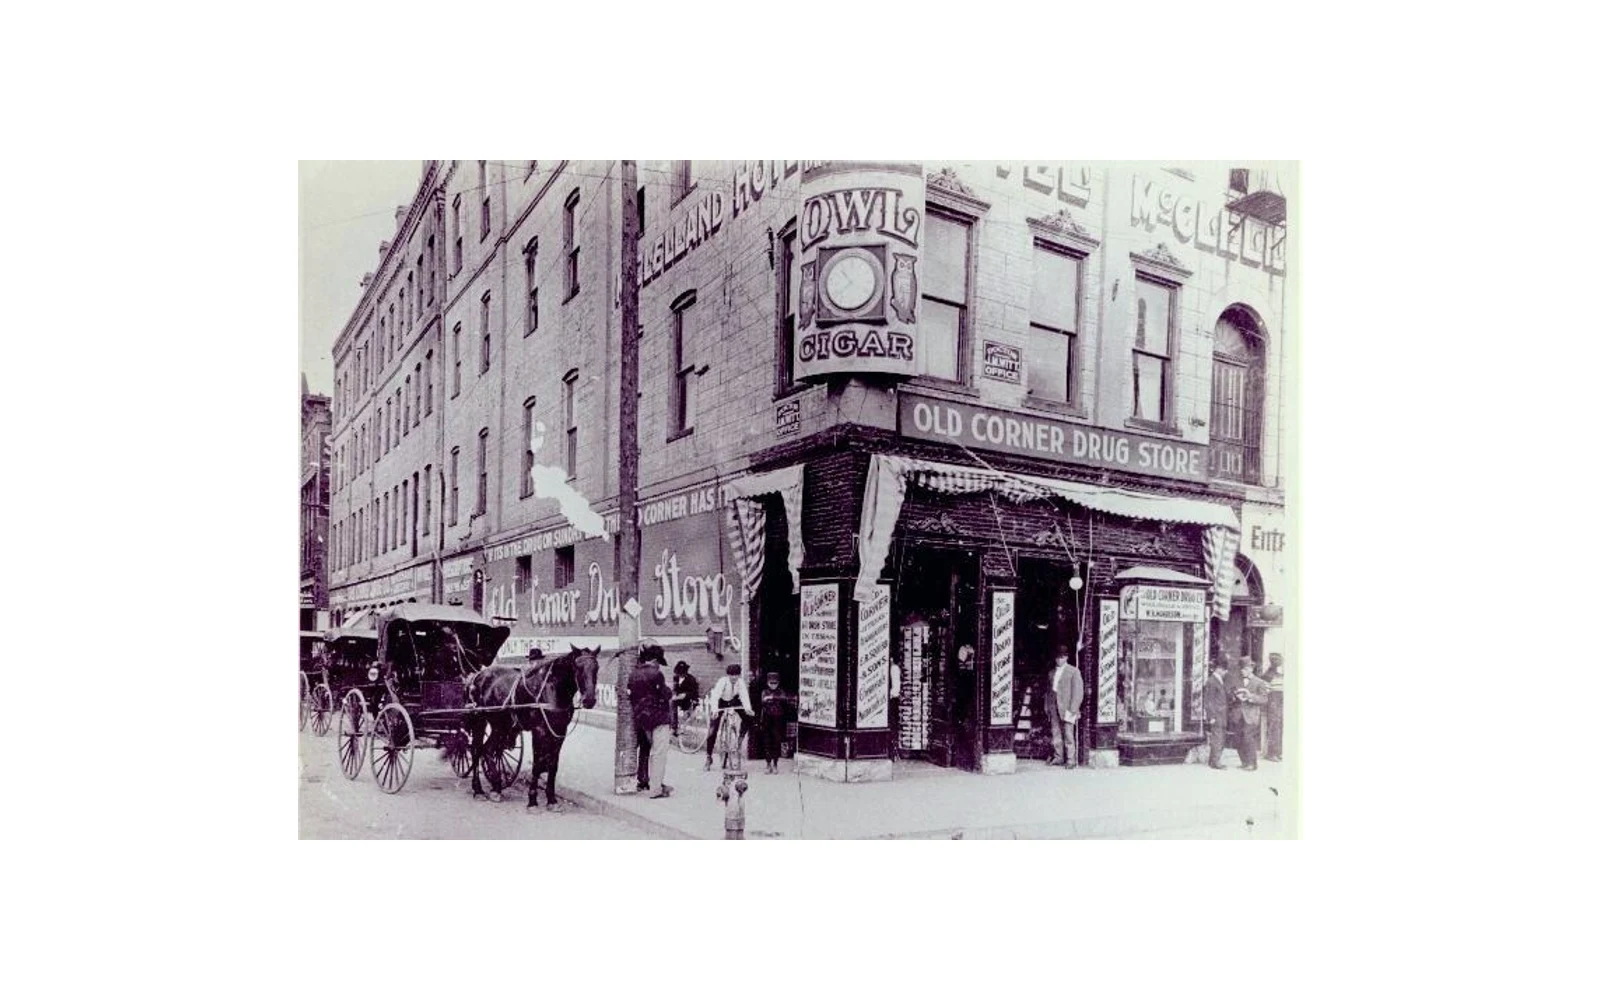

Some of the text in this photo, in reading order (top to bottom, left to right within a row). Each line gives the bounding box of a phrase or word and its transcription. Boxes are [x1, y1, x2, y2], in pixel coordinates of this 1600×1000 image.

[801, 187, 921, 252] OWL
[800, 330, 914, 361] CIGAR
[913, 402, 1200, 475] OLD CORNER DRUG STORE
[644, 496, 687, 526] CORNER
[689, 489, 715, 514] HAS
[532, 575, 581, 625] Corner
[584, 562, 620, 627] Dru
[654, 549, 733, 627] Store
[861, 595, 889, 621] CORNER
[867, 656, 887, 675] SONS
